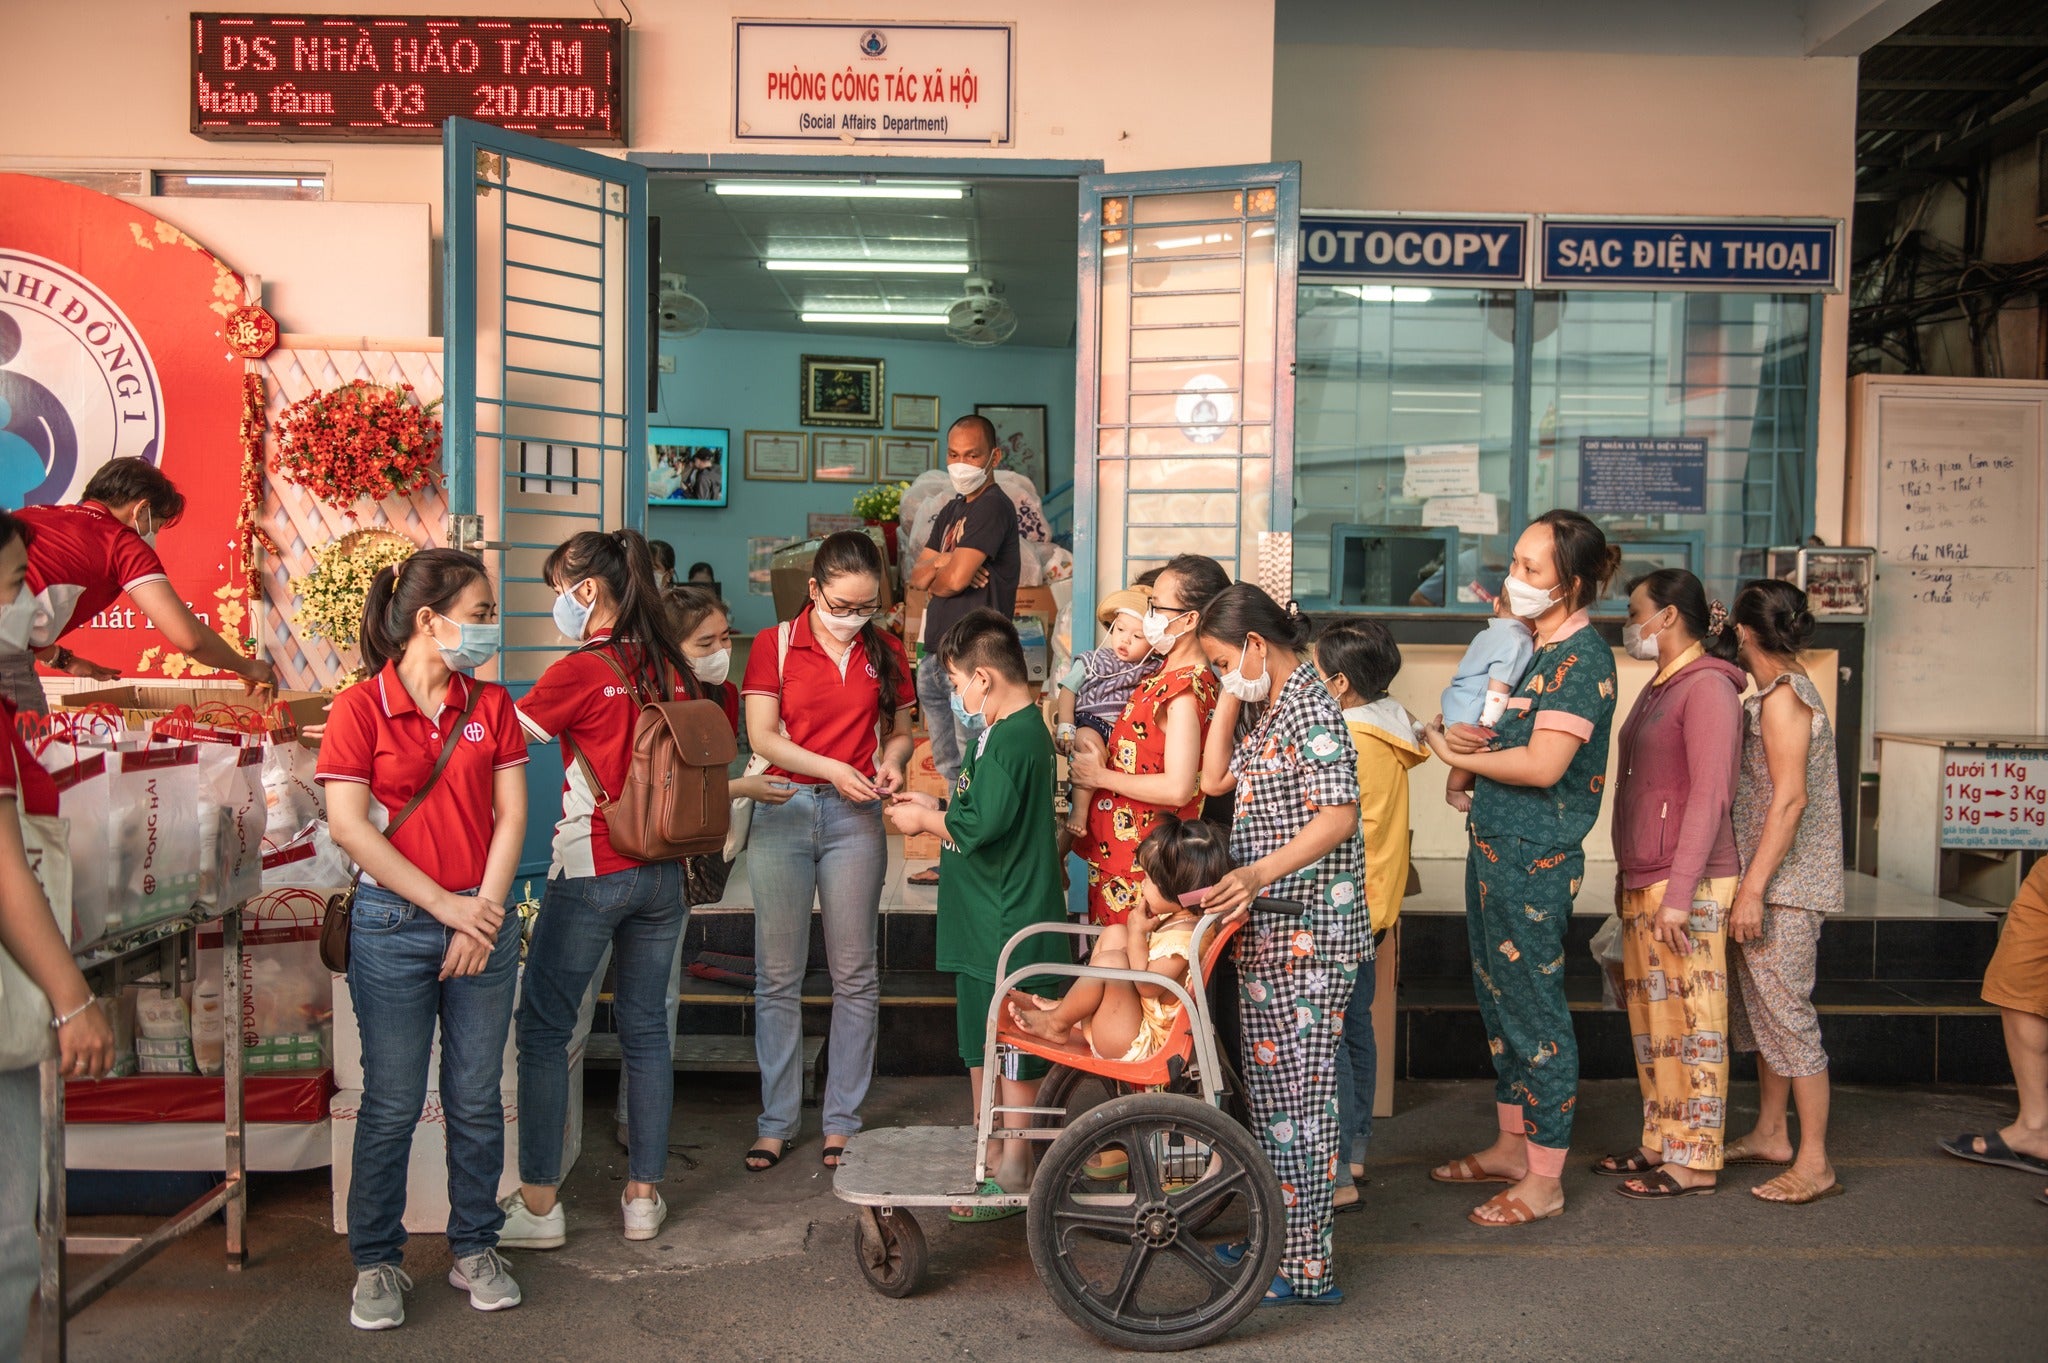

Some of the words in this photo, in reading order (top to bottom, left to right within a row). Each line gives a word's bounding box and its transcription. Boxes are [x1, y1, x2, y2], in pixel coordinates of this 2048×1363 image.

[223, 36, 278, 71] DS
[294, 28, 380, 73] NHÀ
[393, 29, 480, 74] HẢO
[495, 31, 583, 77] TÂM
[268, 82, 335, 114] tâm
[373, 83, 425, 125] Q3
[767, 65, 827, 101] PHÒNG
[831, 66, 880, 102] CÔNG
[884, 67, 918, 103] TÁC
[922, 68, 945, 103] XÃ
[949, 68, 978, 109] HỘI
[799, 113, 836, 132] (Social
[841, 115, 877, 131] Affairs
[882, 115, 949, 135] Department)
[1299, 230, 1510, 266] OTOCOPY
[1557, 238, 1623, 273] SẠC
[1632, 233, 1712, 273] ĐIỆN
[1721, 240, 1821, 276] THOẠI
[59, 295, 143, 400] ĐỒNG
[123, 410, 148, 424] 1
[78, 605, 136, 629] hát
[1945, 762, 1985, 778] dưới
[1991, 762, 1998, 778] 1
[2004, 762, 2027, 782] Kg
[1946, 784, 1953, 799] 1
[1959, 784, 1982, 804] Kg
[2010, 785, 2019, 801] 3
[2024, 785, 2047, 805] Kg
[1944, 806, 1953, 821] 3
[1958, 806, 1981, 825] Kg
[2009, 807, 2019, 822] 5
[2023, 807, 2046, 827] Kg
